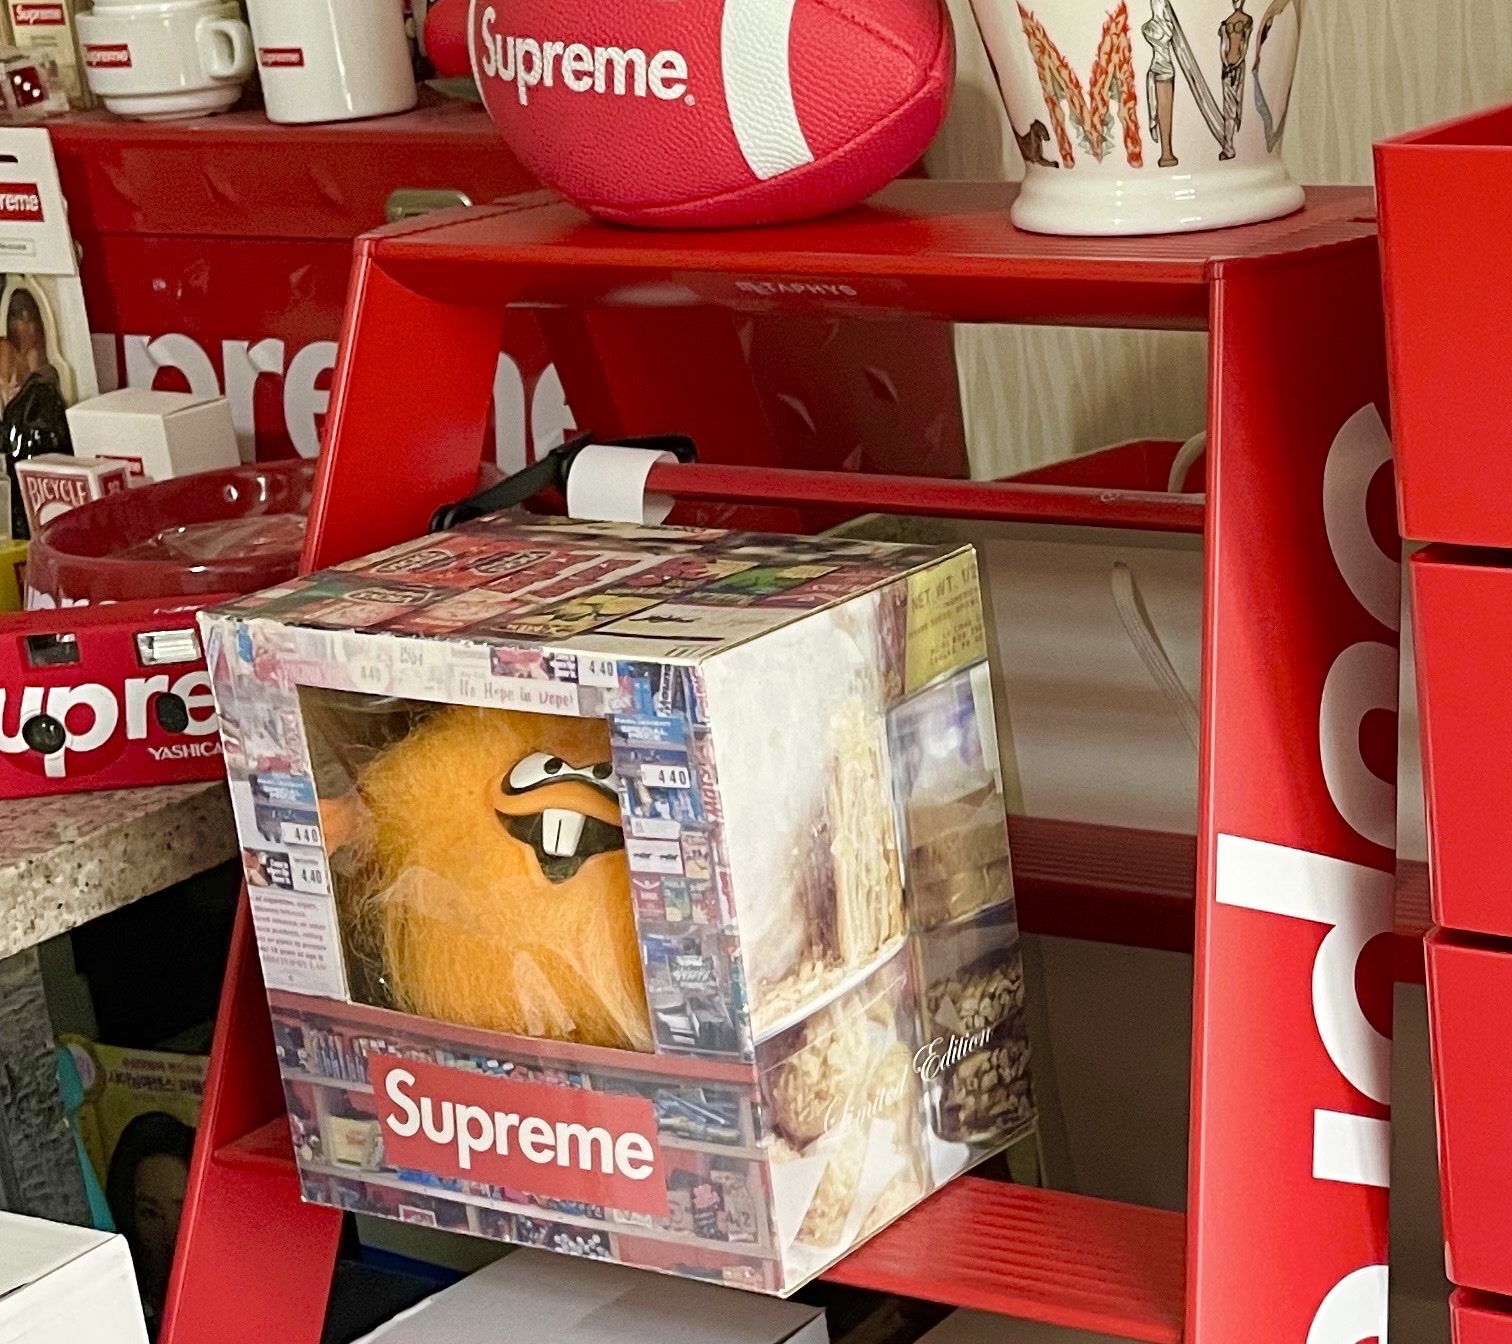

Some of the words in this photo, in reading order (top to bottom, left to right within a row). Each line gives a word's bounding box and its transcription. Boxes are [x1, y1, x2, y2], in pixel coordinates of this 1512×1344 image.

[481, 5, 688, 106] Supreme
[0, 193, 39, 214] reme
[911, 588, 930, 614] NET
[0, 671, 222, 778] upre
[148, 742, 224, 760] YASHICA
[384, 1067, 655, 1181] Supreme
[824, 1067, 909, 1134] Limited
[913, 1027, 995, 1082] Edition
